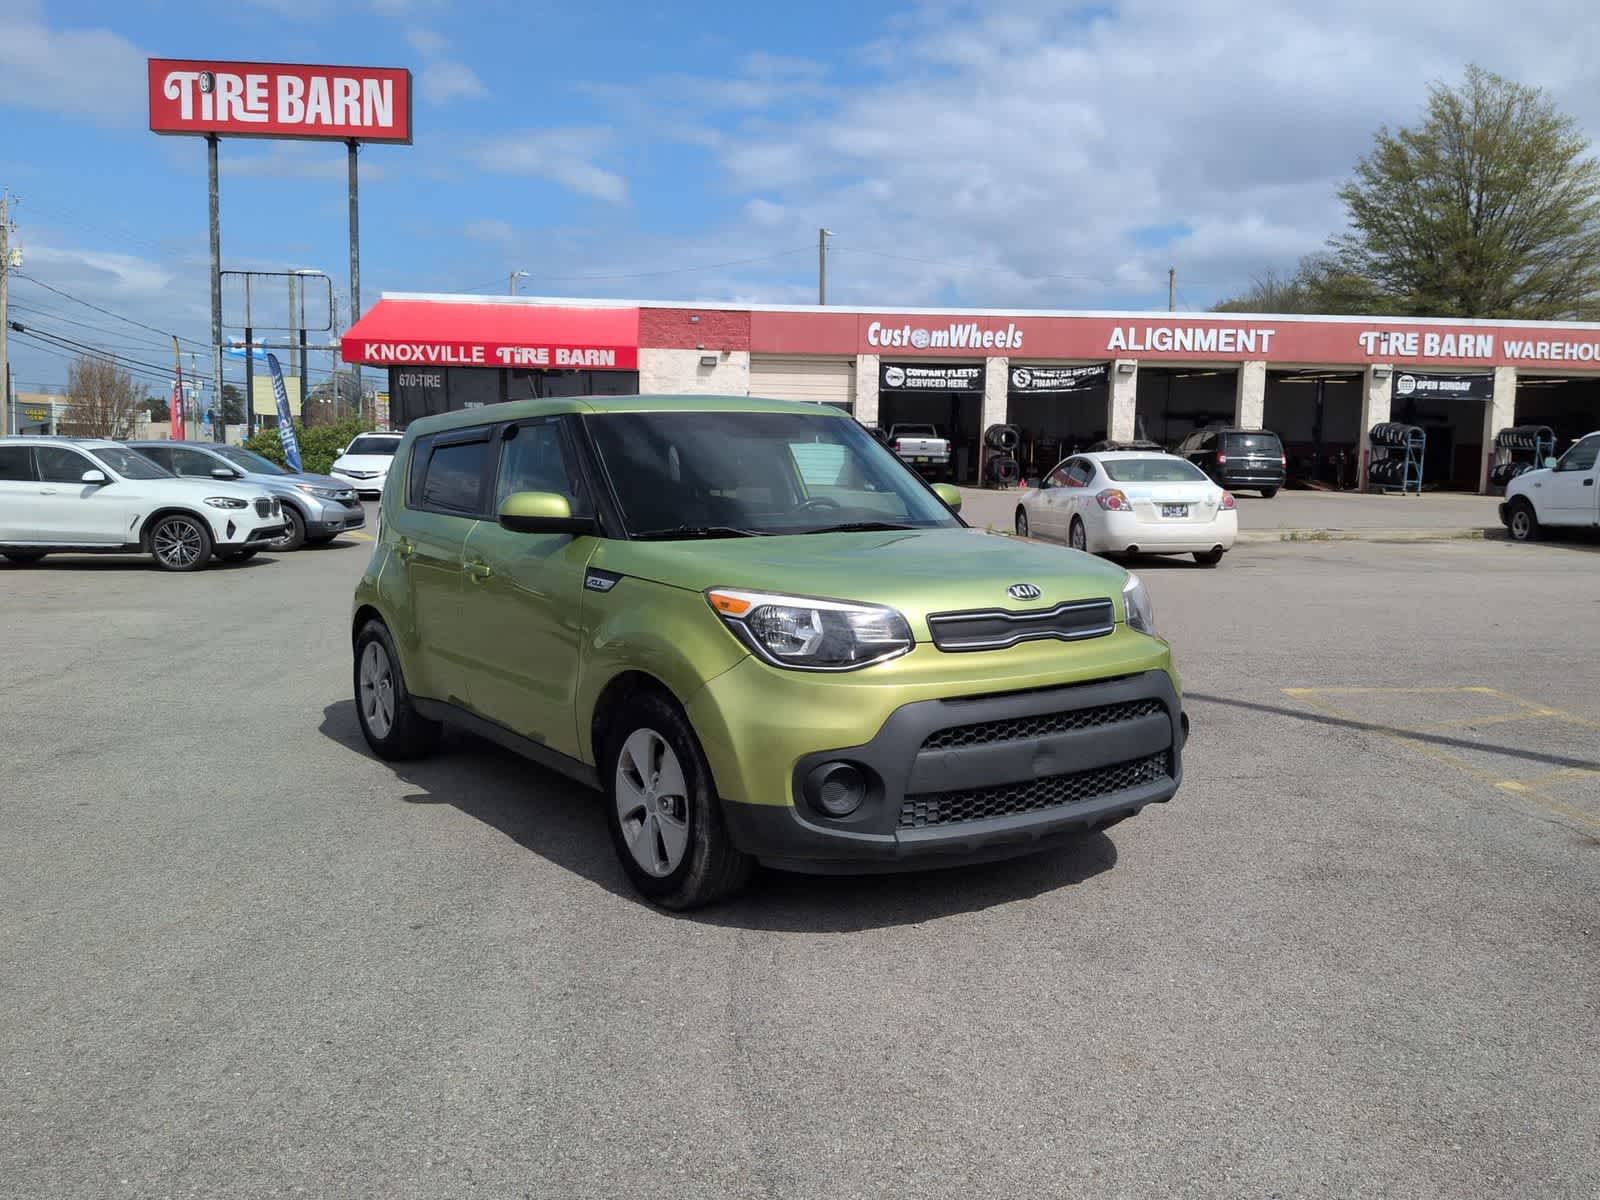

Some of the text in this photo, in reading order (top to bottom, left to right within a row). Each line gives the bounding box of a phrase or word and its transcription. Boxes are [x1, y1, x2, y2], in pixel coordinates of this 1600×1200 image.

[276, 74, 393, 127] BARN
[1107, 327, 1276, 353] ALIGNMENT
[1423, 333, 1494, 358] BARN
[364, 343, 485, 362] KNOXVILLE
[555, 348, 616, 366] BARN
[399, 374, 441, 388] 670-TIRE
[905, 378, 969, 388] SERVICED HERE
[1416, 380, 1471, 391] OPEN SUNDAY
